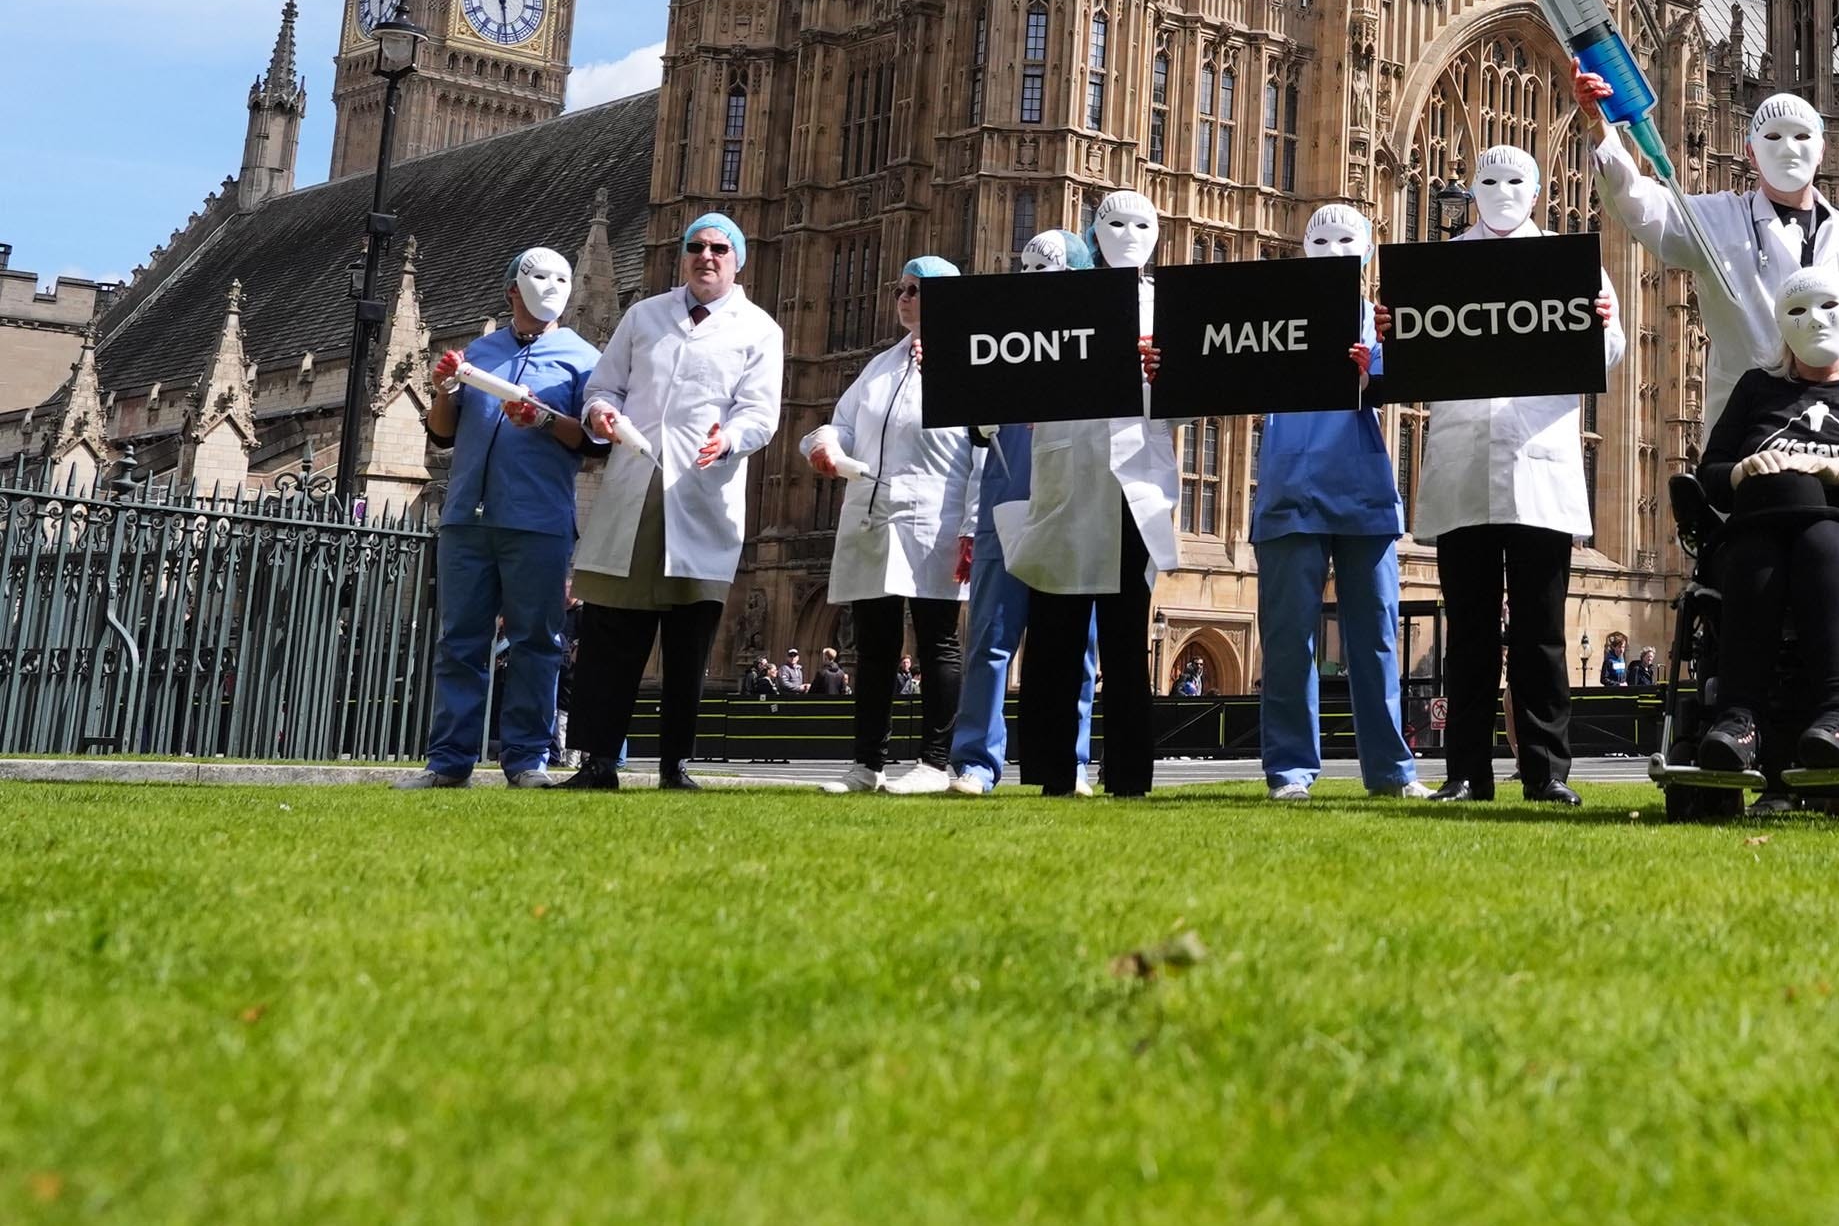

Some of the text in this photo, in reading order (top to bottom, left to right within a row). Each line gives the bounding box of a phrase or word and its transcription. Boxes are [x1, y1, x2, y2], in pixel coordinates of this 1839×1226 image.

[1202, 318, 1309, 355] MAKE
[1395, 297, 1592, 340] DOCTORS
[970, 328, 1096, 366] DON'T
